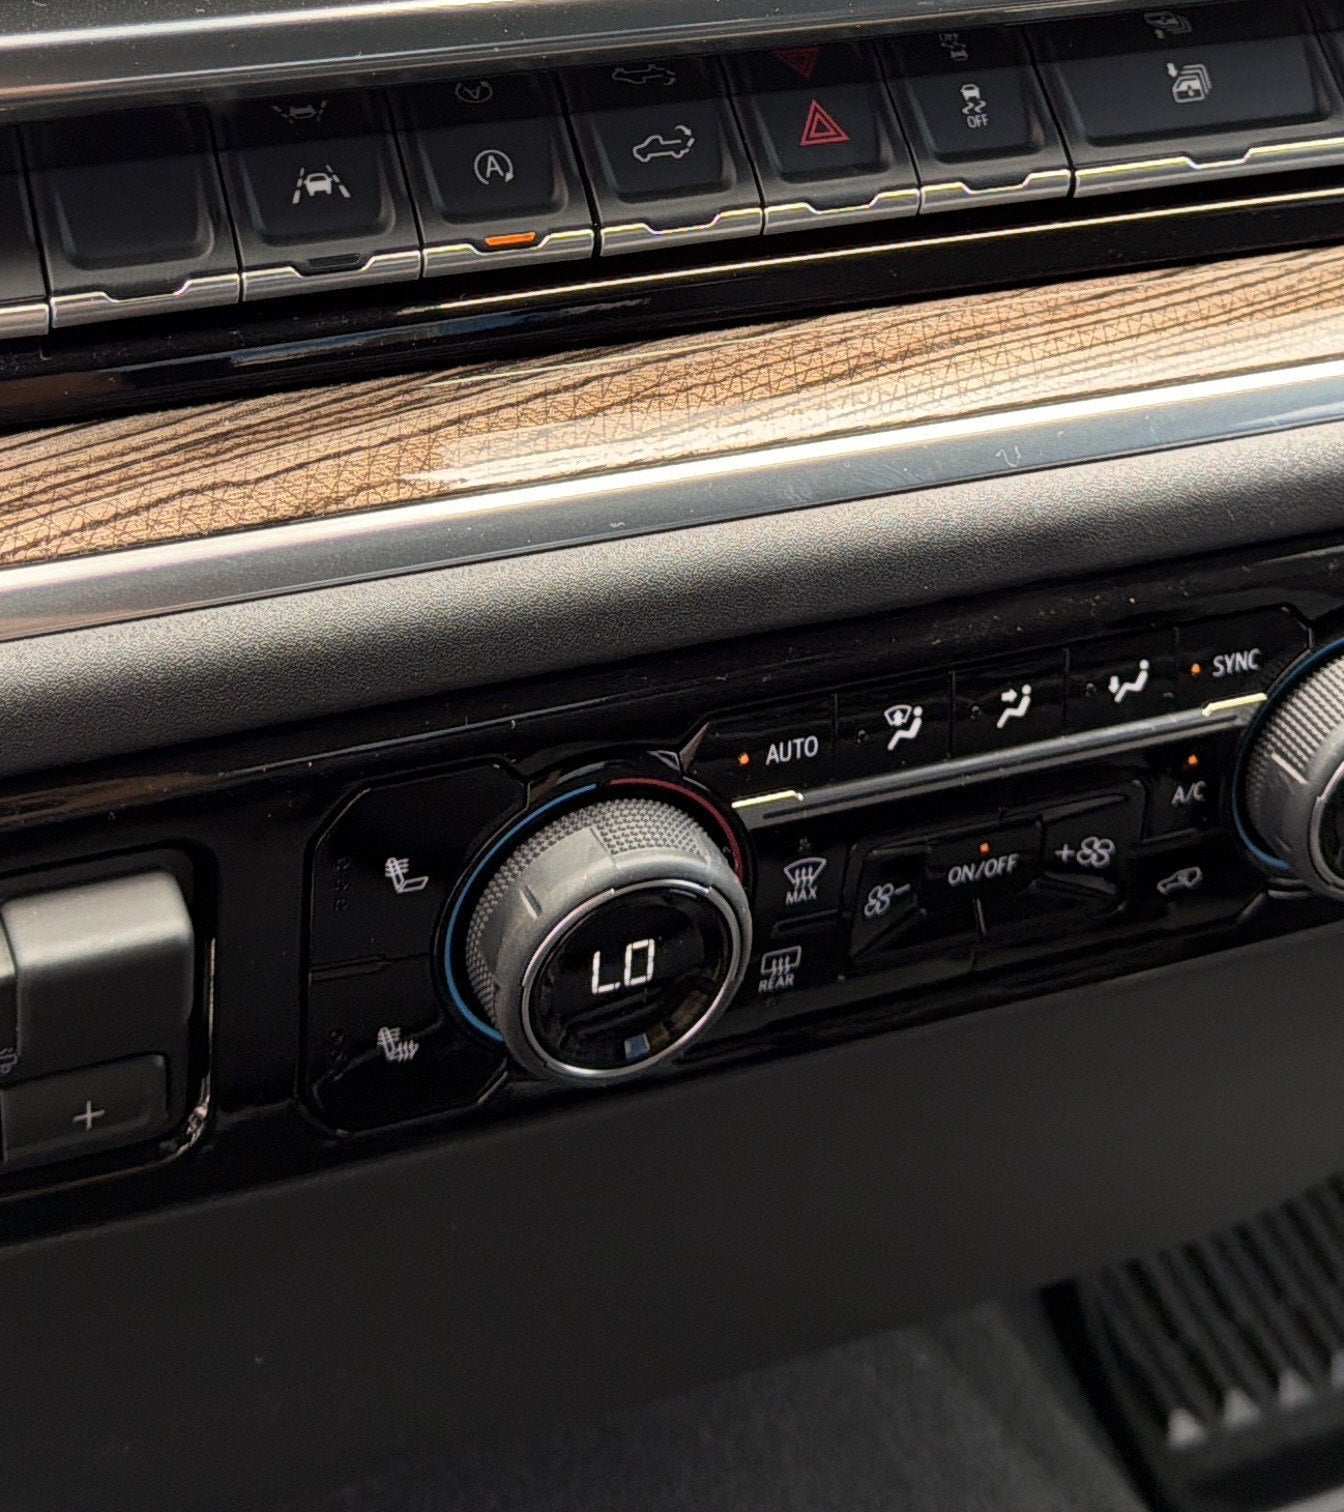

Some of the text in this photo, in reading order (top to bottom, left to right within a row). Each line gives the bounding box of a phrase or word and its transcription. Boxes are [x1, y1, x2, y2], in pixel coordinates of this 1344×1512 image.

[966, 113, 989, 129] OFF
[1212, 648, 1261, 678] SYNC
[765, 735, 819, 766] AUTO
[1171, 781, 1206, 808] A/C
[948, 853, 1019, 887] ON/OFF
[785, 886, 818, 907] MAX
